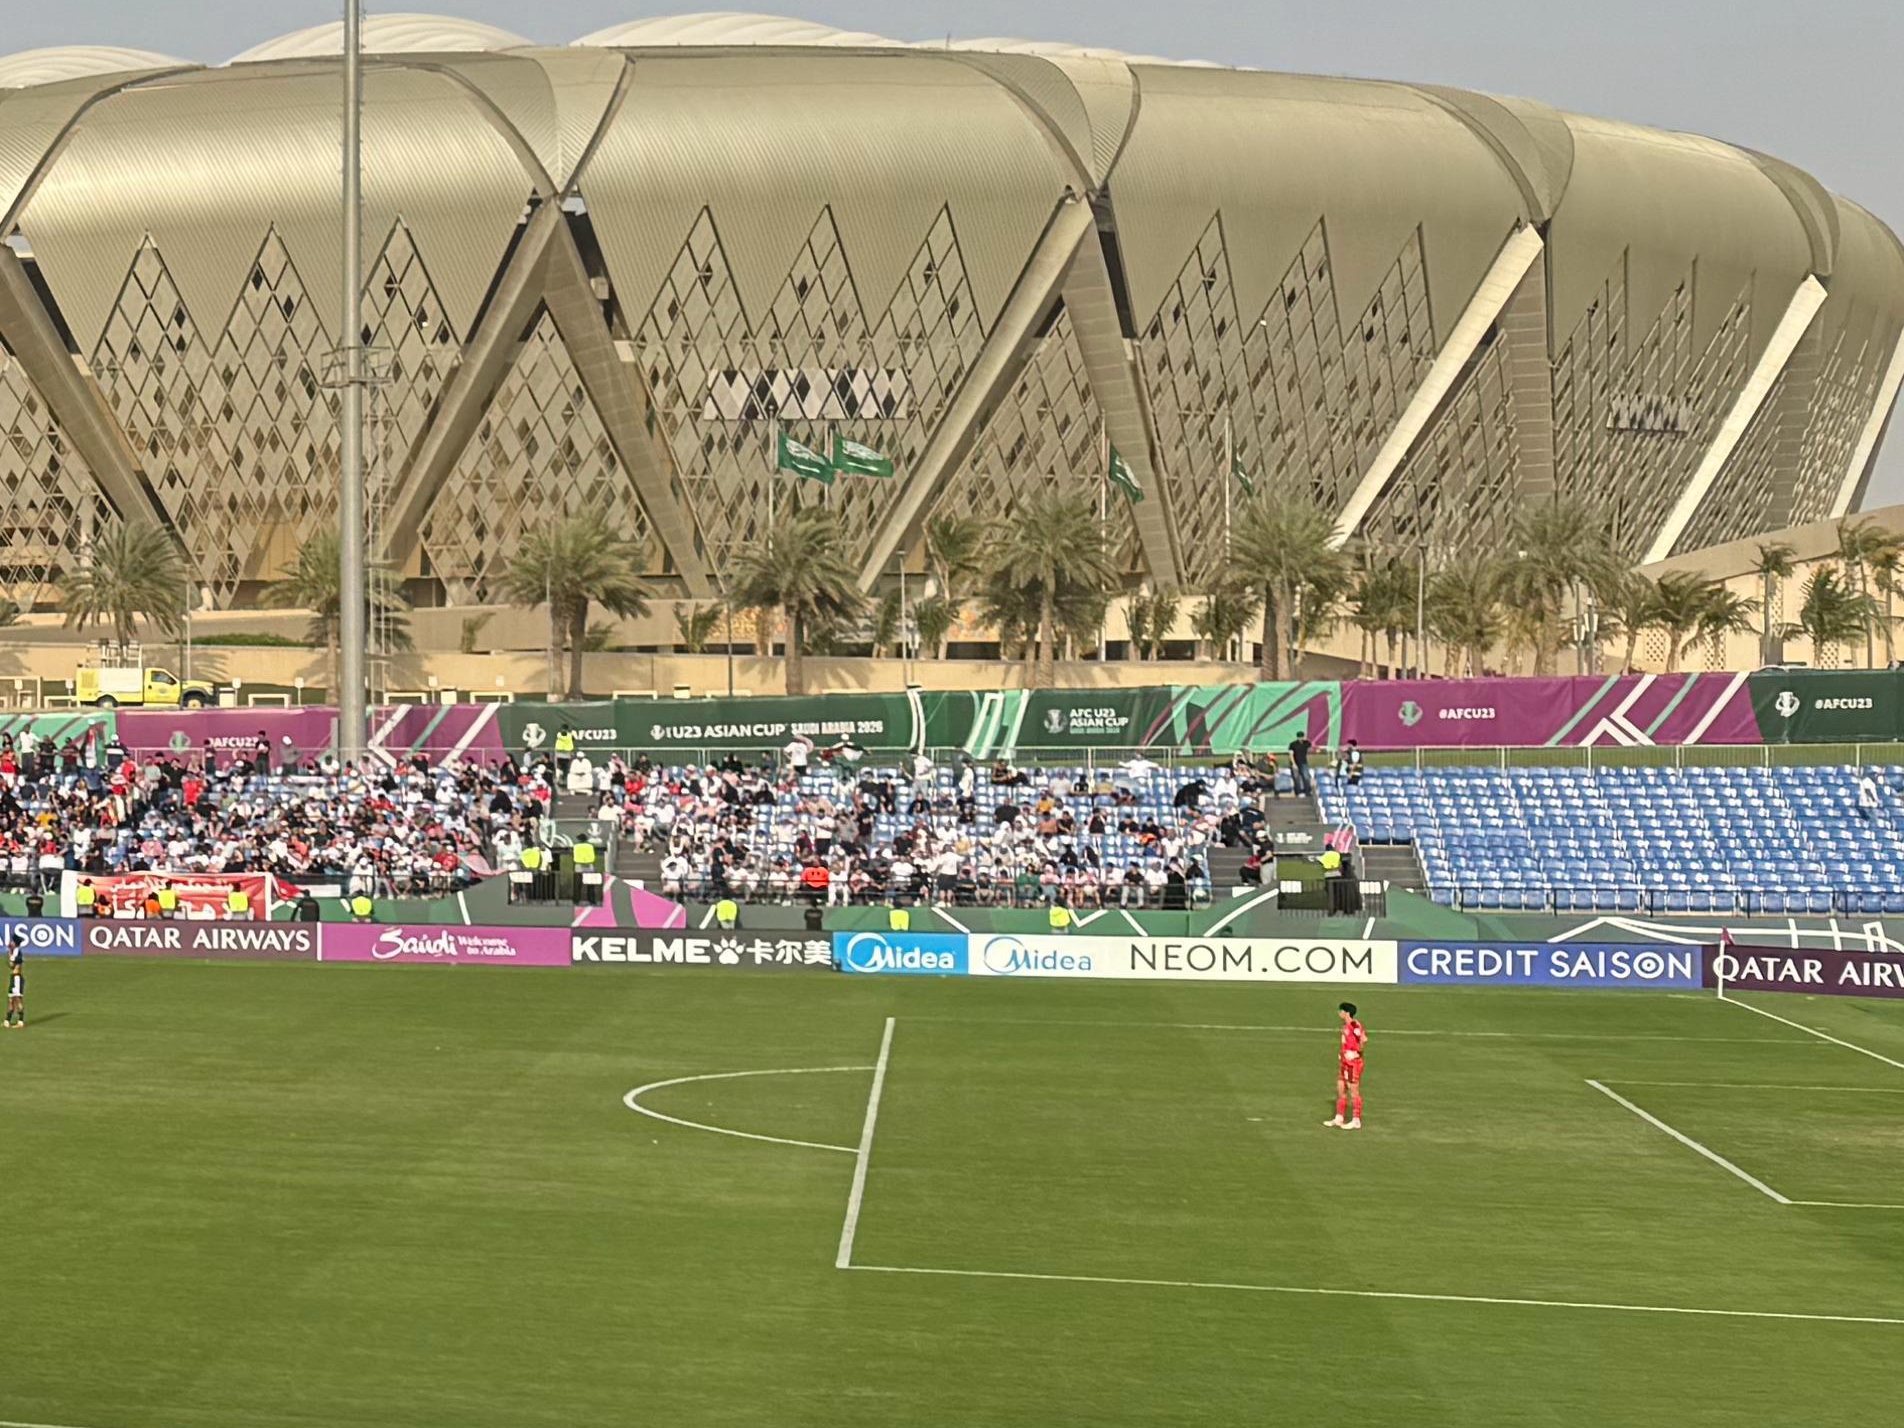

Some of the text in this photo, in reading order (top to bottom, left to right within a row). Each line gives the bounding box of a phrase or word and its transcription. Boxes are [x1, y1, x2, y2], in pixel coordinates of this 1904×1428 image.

[1439, 707, 1496, 720] #AFCU23
[1814, 698, 1873, 711] #AFCU23
[570, 728, 617, 741] AFCU23
[671, 725, 702, 739] U23
[704, 724, 755, 738] ASIAN
[757, 723, 785, 737] CUP
[857, 721, 884, 734] 2026
[89, 926, 311, 952] QATAR AIRWAYS
[572, 937, 833, 965] KELME 卡尔美
[868, 944, 955, 970] Midea
[1007, 949, 1092, 971] Midea
[1131, 943, 1372, 975] NEOM.COM
[1407, 947, 1691, 980] CREDIT SAISON
[1713, 955, 1824, 984] QATAR
